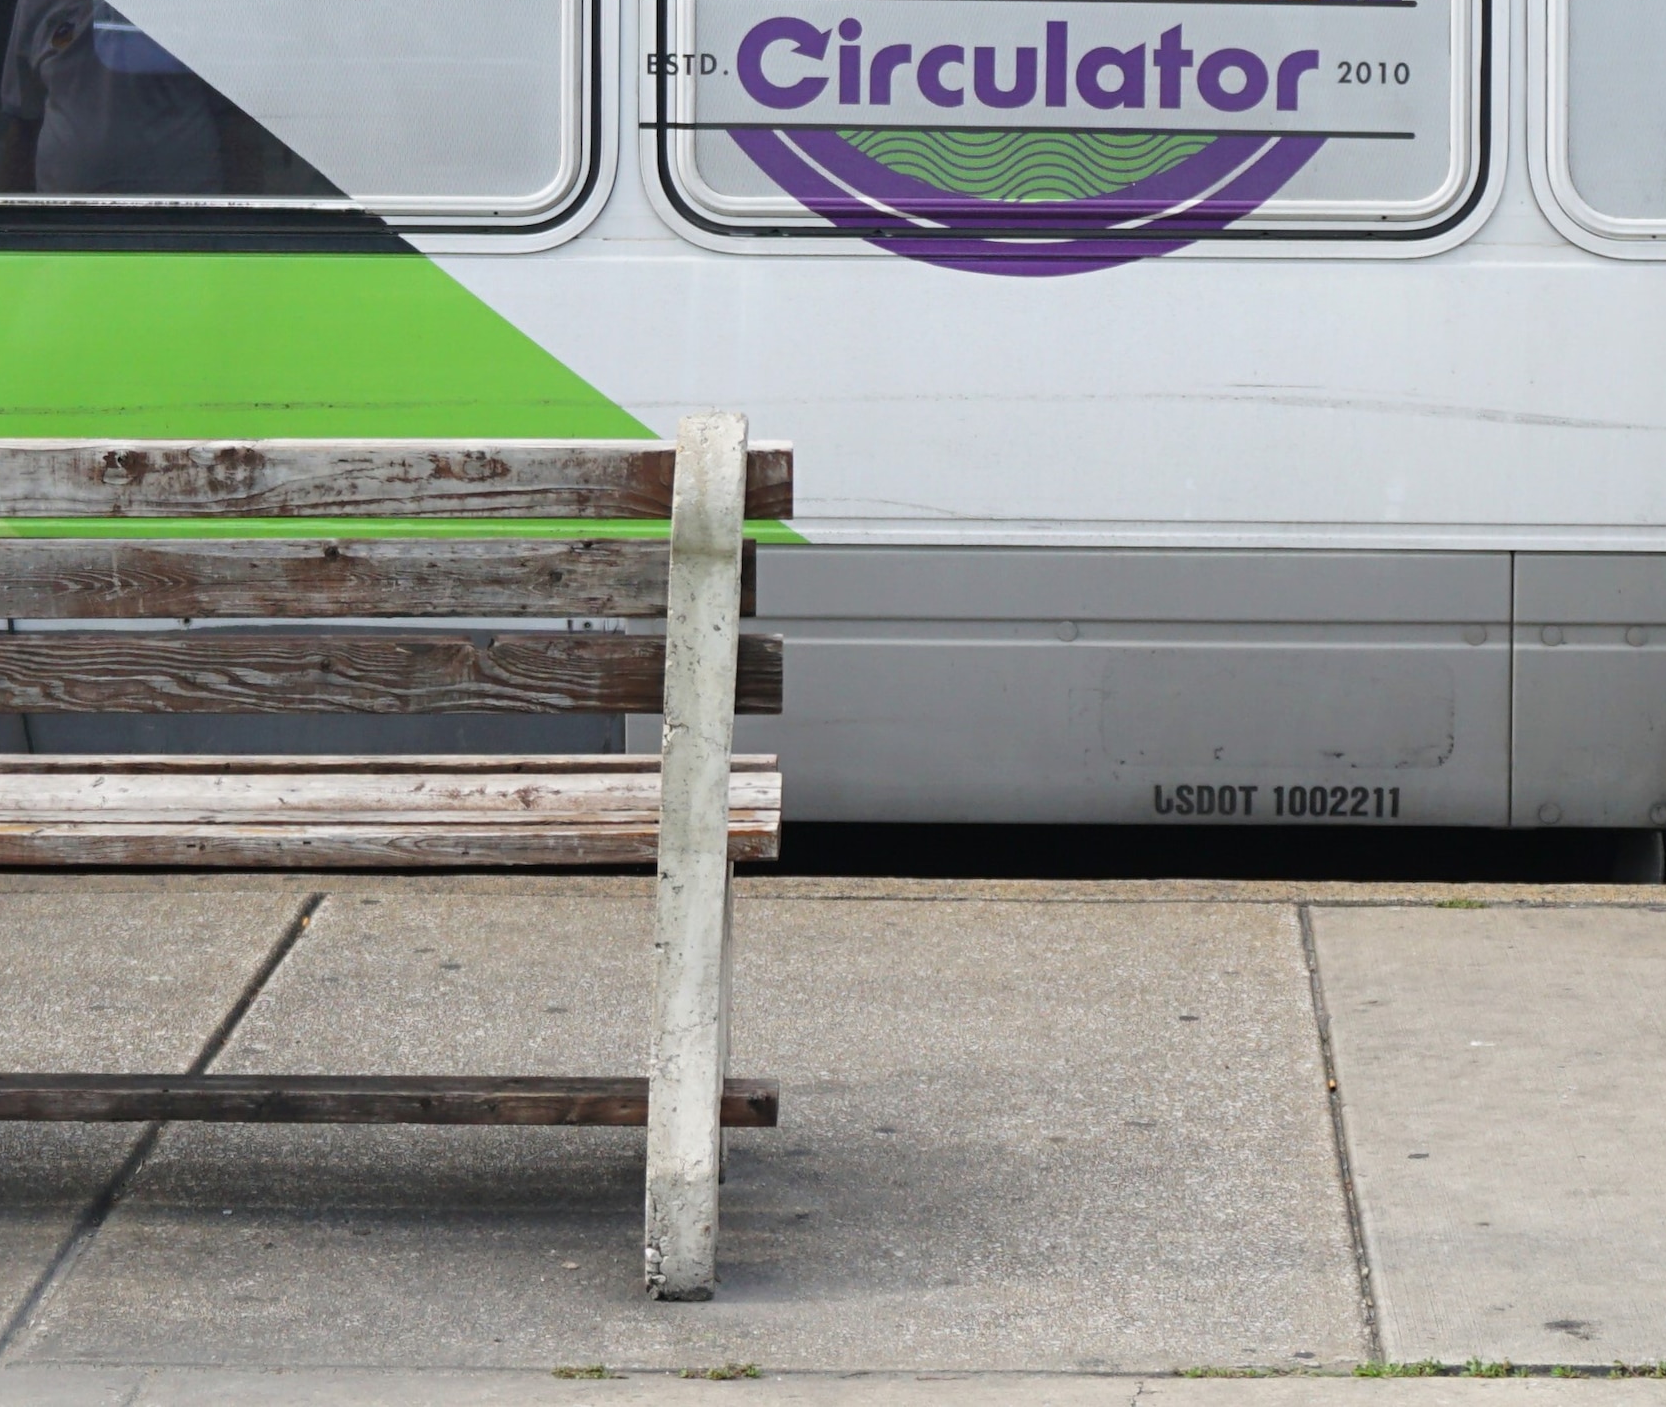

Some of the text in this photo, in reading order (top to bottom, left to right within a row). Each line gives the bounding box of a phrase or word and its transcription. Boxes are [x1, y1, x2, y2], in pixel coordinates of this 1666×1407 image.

[646, 50, 729, 77] ESTD.
[736, 15, 1321, 113] Circulator
[1336, 61, 1412, 86] 2010
[1154, 784, 1401, 818] USDOT 1002211
